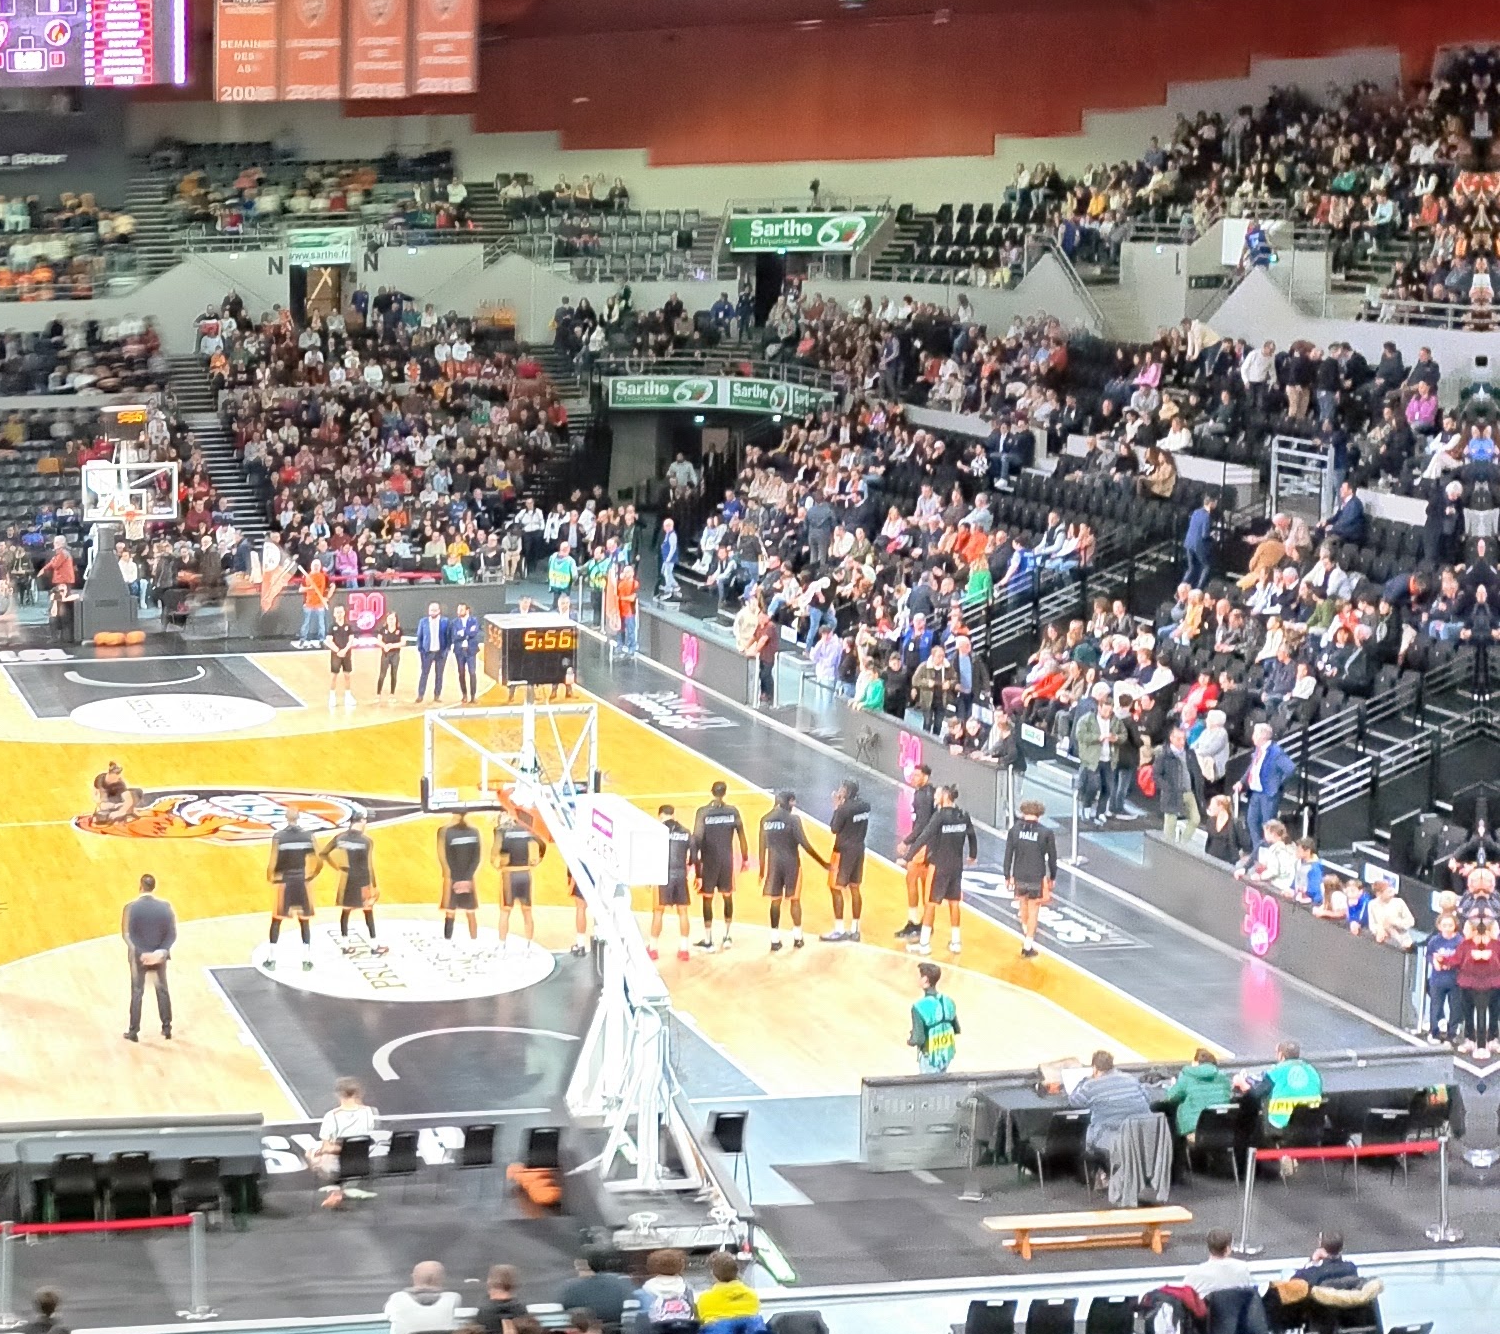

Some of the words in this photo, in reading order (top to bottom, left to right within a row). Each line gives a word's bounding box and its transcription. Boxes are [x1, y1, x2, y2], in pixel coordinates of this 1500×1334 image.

[750, 219, 813, 237] Sarthe
[268, 256, 283, 275] N
[363, 253, 379, 272] N
[616, 380, 669, 396] Sarthe
[733, 382, 769, 399] Sarthe
[524, 628, 572, 650] 5:56
